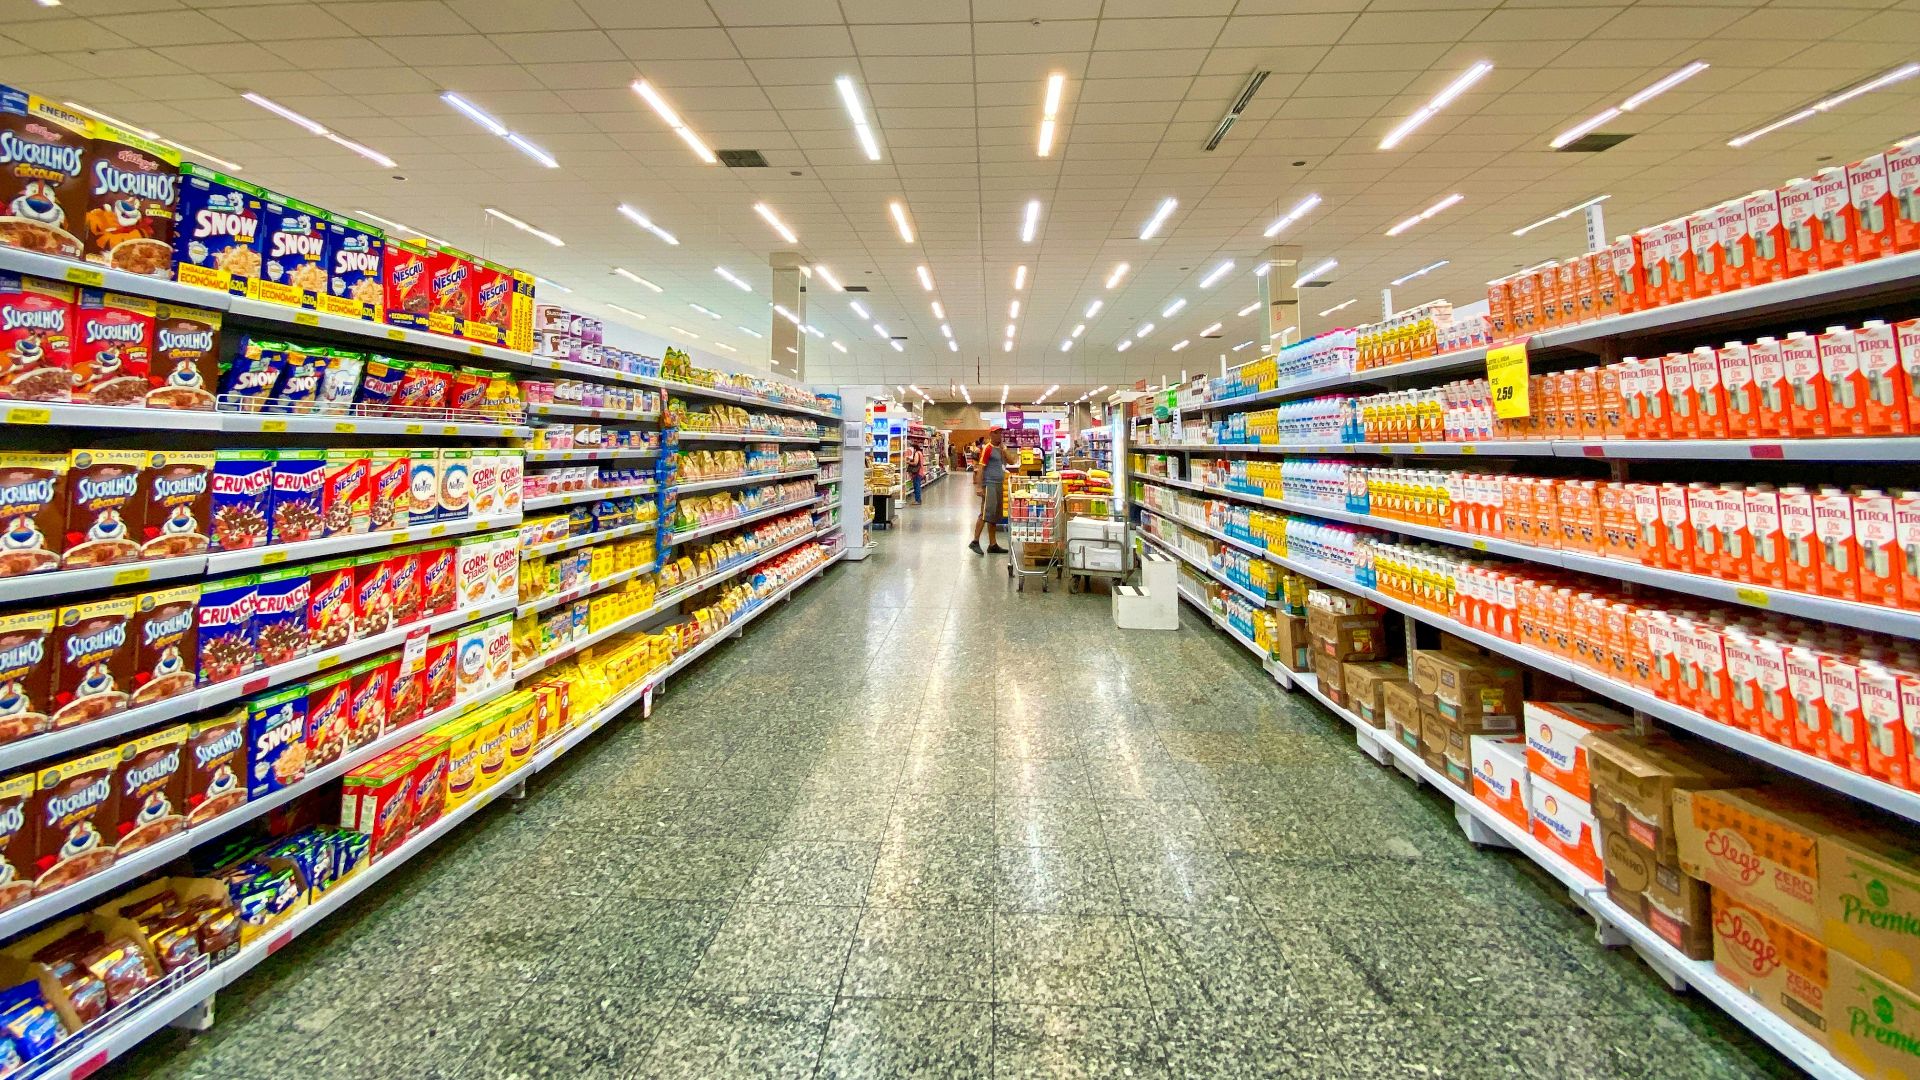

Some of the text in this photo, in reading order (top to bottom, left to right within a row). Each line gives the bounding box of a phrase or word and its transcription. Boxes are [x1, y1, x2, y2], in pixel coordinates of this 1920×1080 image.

[38, 103, 86, 127] ENERGIA
[0, 131, 83, 177] SUCRILHOS
[95, 161, 176, 205] SUCRILHOS
[1851, 168, 1885, 185] TIROL
[1781, 191, 1813, 207] TIROL
[1813, 180, 1846, 197] TIROL
[1717, 212, 1745, 227] TIROL
[1748, 202, 1777, 217] TIROL
[194, 209, 258, 238] SNOW
[1690, 222, 1715, 235] TIROL
[271, 231, 323, 257] SNOW
[1664, 231, 1686, 243] TIROL
[181, 264, 218, 278] EMBALAGEM
[335, 250, 380, 275] SNOW
[392, 262, 424, 285] NESCAU
[432, 266, 468, 293] NESCAU
[478, 280, 509, 305] NESCAU
[2, 306, 65, 331] SUCRILHOS
[86, 320, 144, 344] SUCRILHOS
[159, 330, 214, 352] SUCRILHOS
[1783, 348, 1816, 361] TIROL
[1821, 343, 1855, 356] TIROL
[1858, 338, 1893, 352] TIROL
[1665, 364, 1690, 375] TIROL
[1691, 361, 1716, 372] TIROL
[1720, 356, 1749, 368] TIROL
[1752, 353, 1780, 365] TIROL
[234, 371, 280, 390] SNOW
[400, 377, 428, 399] NESCAU
[108, 451, 147, 459] SABOR
[181, 451, 215, 459] SABOR
[213, 470, 272, 493] CRUNCH
[274, 468, 326, 490] CRUNCH
[334, 467, 366, 493] NESCAU
[378, 463, 407, 490] NESCAU
[473, 467, 496, 485] CORN
[500, 467, 521, 483] CORN
[79, 473, 138, 504] SUCRILHOS
[154, 472, 208, 501] SUCRILHOS
[1660, 496, 1685, 507] TIROL
[1690, 498, 1714, 510] TIROL
[1714, 500, 1743, 512] TIROL
[1745, 502, 1776, 515] TIROL
[1781, 504, 1811, 517] TIROL
[1815, 507, 1850, 520] TIROL
[1855, 508, 1892, 523] TIROL
[425, 551, 453, 584] NESCAU
[462, 552, 488, 574] CORN
[492, 548, 515, 569] CORN
[169, 587, 200, 599] SABOR
[256, 580, 311, 614] CRUNCH
[311, 577, 350, 617] NESCAU
[359, 569, 390, 604] NESCAU
[97, 599, 135, 612] SABOR
[199, 591, 257, 625] CRUNCH
[10, 612, 54, 626] SABOR
[144, 607, 194, 646] SUCRILHOS
[67, 622, 127, 664] SUCRILHOS
[488, 633, 509, 656] CORN
[1696, 638, 1721, 655] TIROL
[1725, 646, 1750, 662] TIROL
[427, 646, 456, 684] NESCAU
[1755, 654, 1783, 672] TIROL
[1788, 662, 1819, 681] TIROL
[1822, 671, 1855, 691] TIROL
[1860, 682, 1896, 701] TIROL
[351, 673, 384, 716] NESCAU
[310, 690, 347, 732] NESCAU
[152, 727, 188, 742] SABOR
[256, 716, 305, 761] SNOW
[509, 717, 535, 739] Cheerios
[195, 727, 243, 769] SUCRILHOS
[480, 733, 508, 755] Cheerios
[76, 751, 118, 768] SABOR
[449, 751, 478, 773] Cheerios
[125, 748, 181, 796] SUCRILHOS
[415, 754, 447, 799] NESCAU
[48, 774, 111, 826] SUCRILHOS
[379, 774, 412, 822] NESCAU
[1773, 868, 1814, 895] ZERO
[1785, 968, 1823, 1001] ZERO
